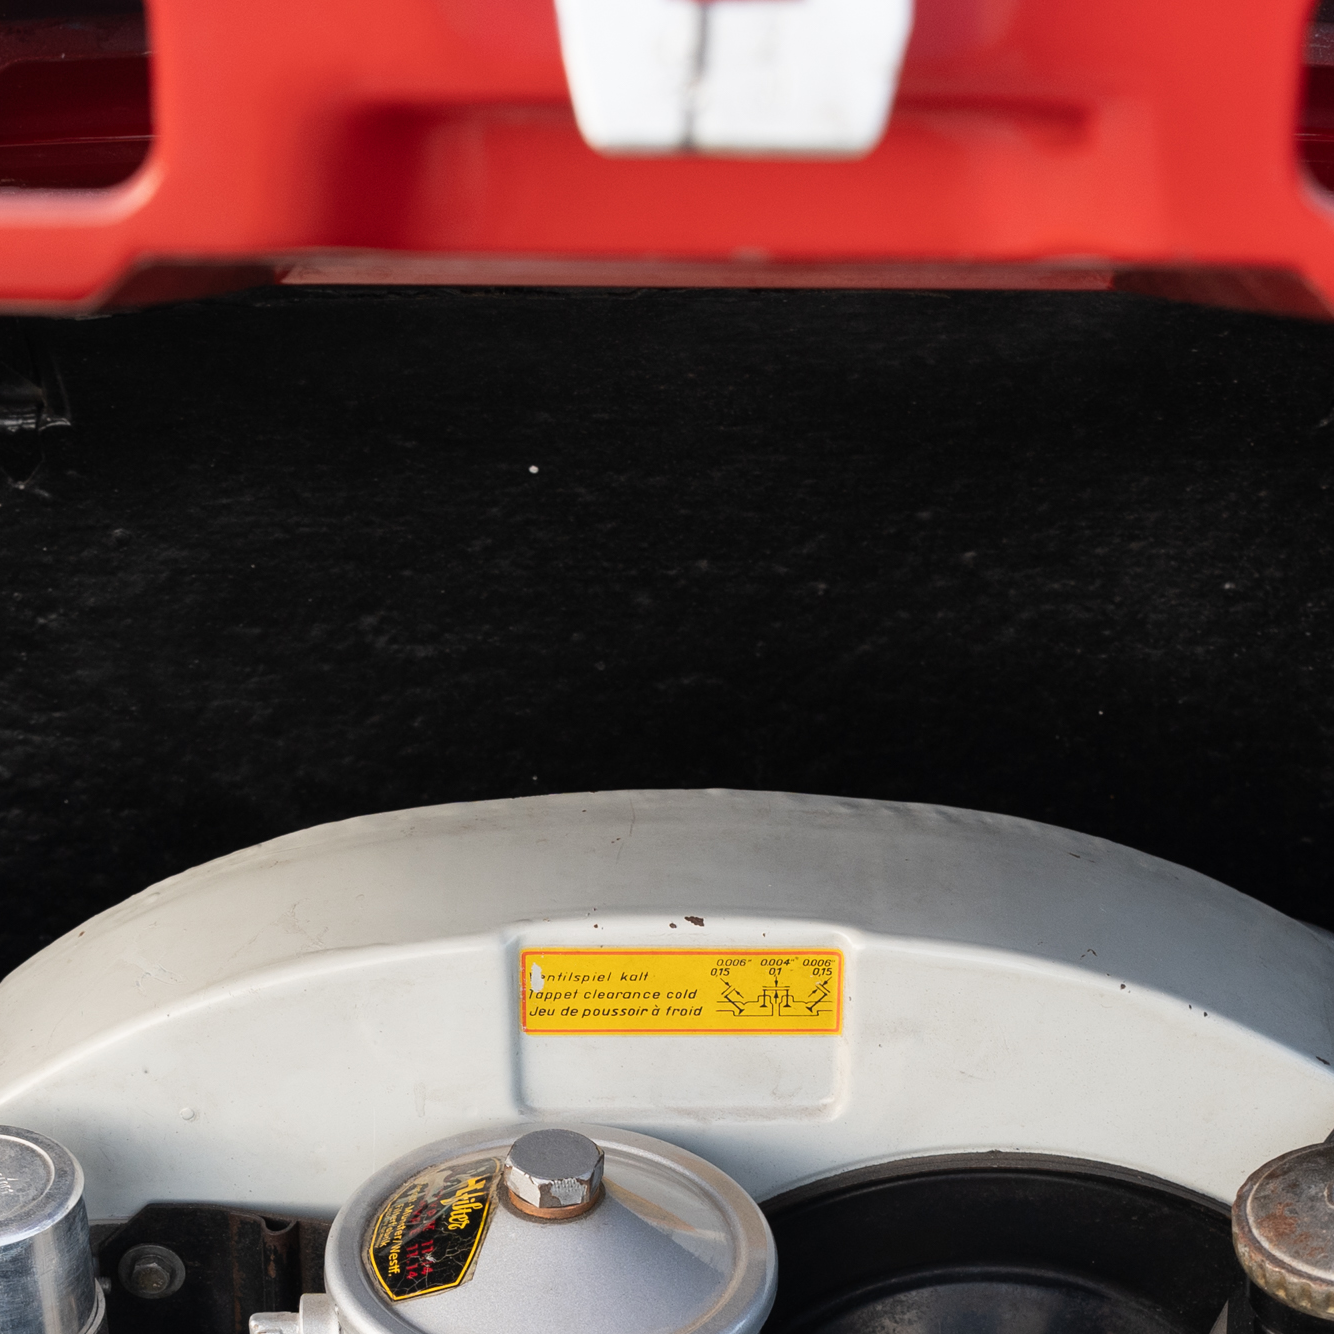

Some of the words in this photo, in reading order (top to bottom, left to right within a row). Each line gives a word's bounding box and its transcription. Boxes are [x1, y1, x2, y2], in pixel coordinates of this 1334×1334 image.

[620, 972, 649, 982] kalt
[583, 988, 661, 1000] clearance
[666, 988, 698, 1000] cold
[529, 1006, 555, 1017] Jeu
[560, 1006, 578, 1017] de
[581, 1006, 648, 1018] poussoir
[651, 1005, 660, 1017] à
[665, 1006, 703, 1017] froid
